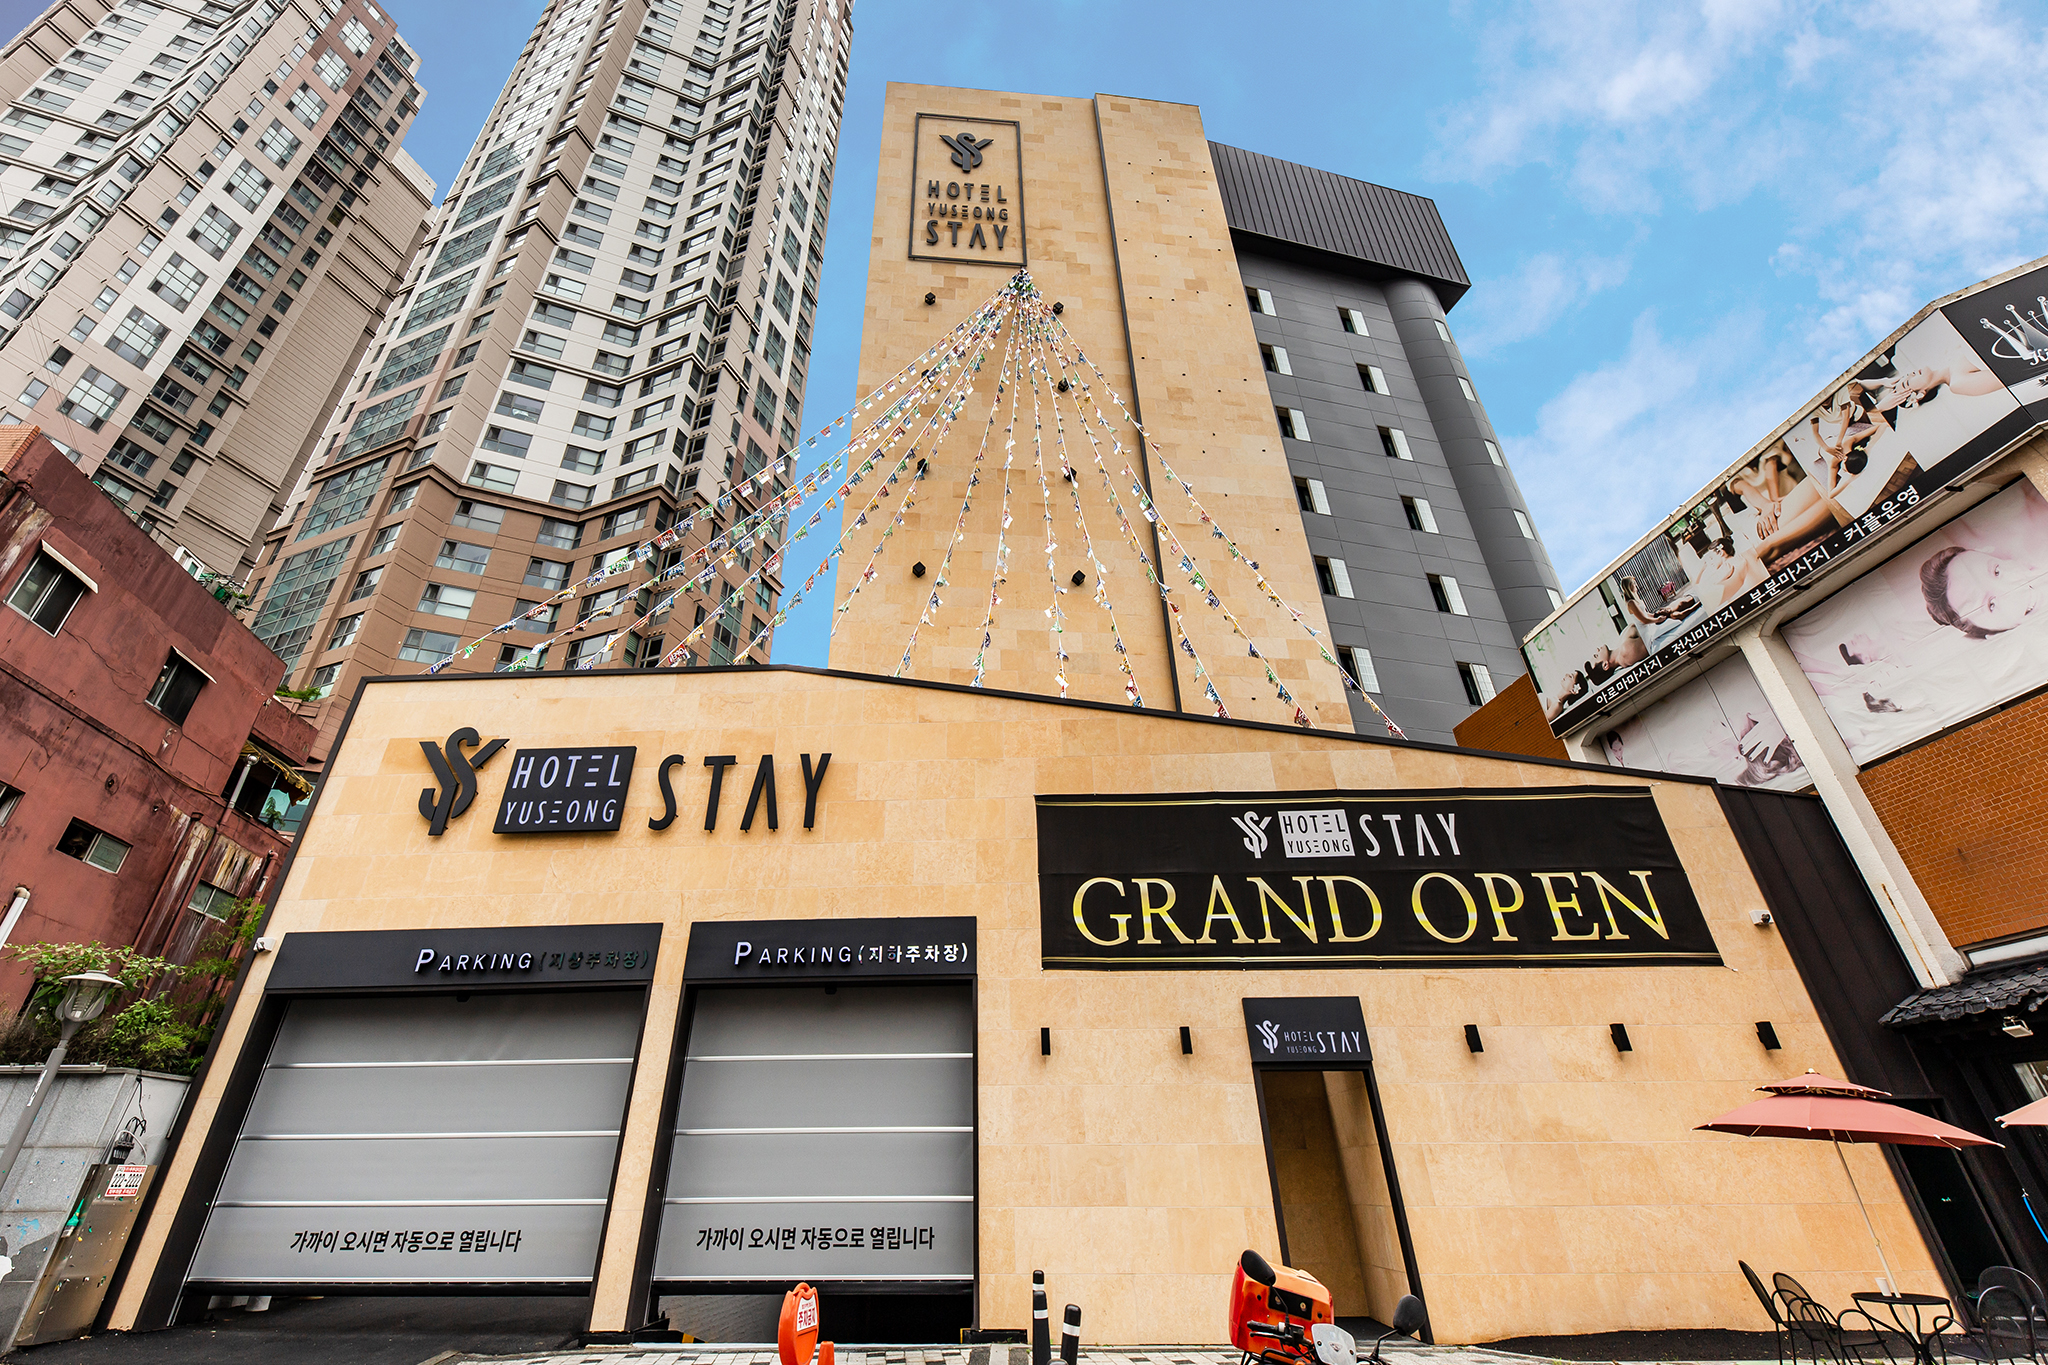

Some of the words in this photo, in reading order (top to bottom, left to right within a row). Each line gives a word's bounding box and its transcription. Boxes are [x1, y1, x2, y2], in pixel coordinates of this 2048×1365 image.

[928, 180, 1007, 203] HOTEL
[928, 203, 1008, 222] YUSEONG
[926, 220, 1008, 250] STAY
[1843, 485, 1920, 541] 커플운영
[1750, 545, 1831, 605] 부분마사지
[1671, 606, 1737, 656] 전신마사지
[1596, 655, 1662, 704] 아로마마사지
[512, 754, 621, 789] HOTEL
[648, 753, 832, 831] STAY
[503, 799, 617, 826] YUSEONG
[1282, 814, 1346, 834] HOTEL
[1287, 839, 1350, 854] YUSEONG
[1359, 813, 1461, 857] STAY
[1072, 874, 1382, 946] GRAND
[1412, 870, 1670, 944] OPEN
[1284, 1031, 1314, 1042] HOTEL
[1286, 1045, 1317, 1054] YUSEONG
[1316, 1031, 1361, 1053] STAY
[290, 1231, 339, 1252] 가까이
[340, 1230, 389, 1253] 오시면
[391, 1230, 455, 1253] 자동으로
[459, 1229, 522, 1253] 열립니다
[696, 1227, 744, 1250] 가까이
[748, 1227, 796, 1250] 오시면
[800, 1227, 864, 1250] 자동으로
[870, 1226, 935, 1250] 열립니다
